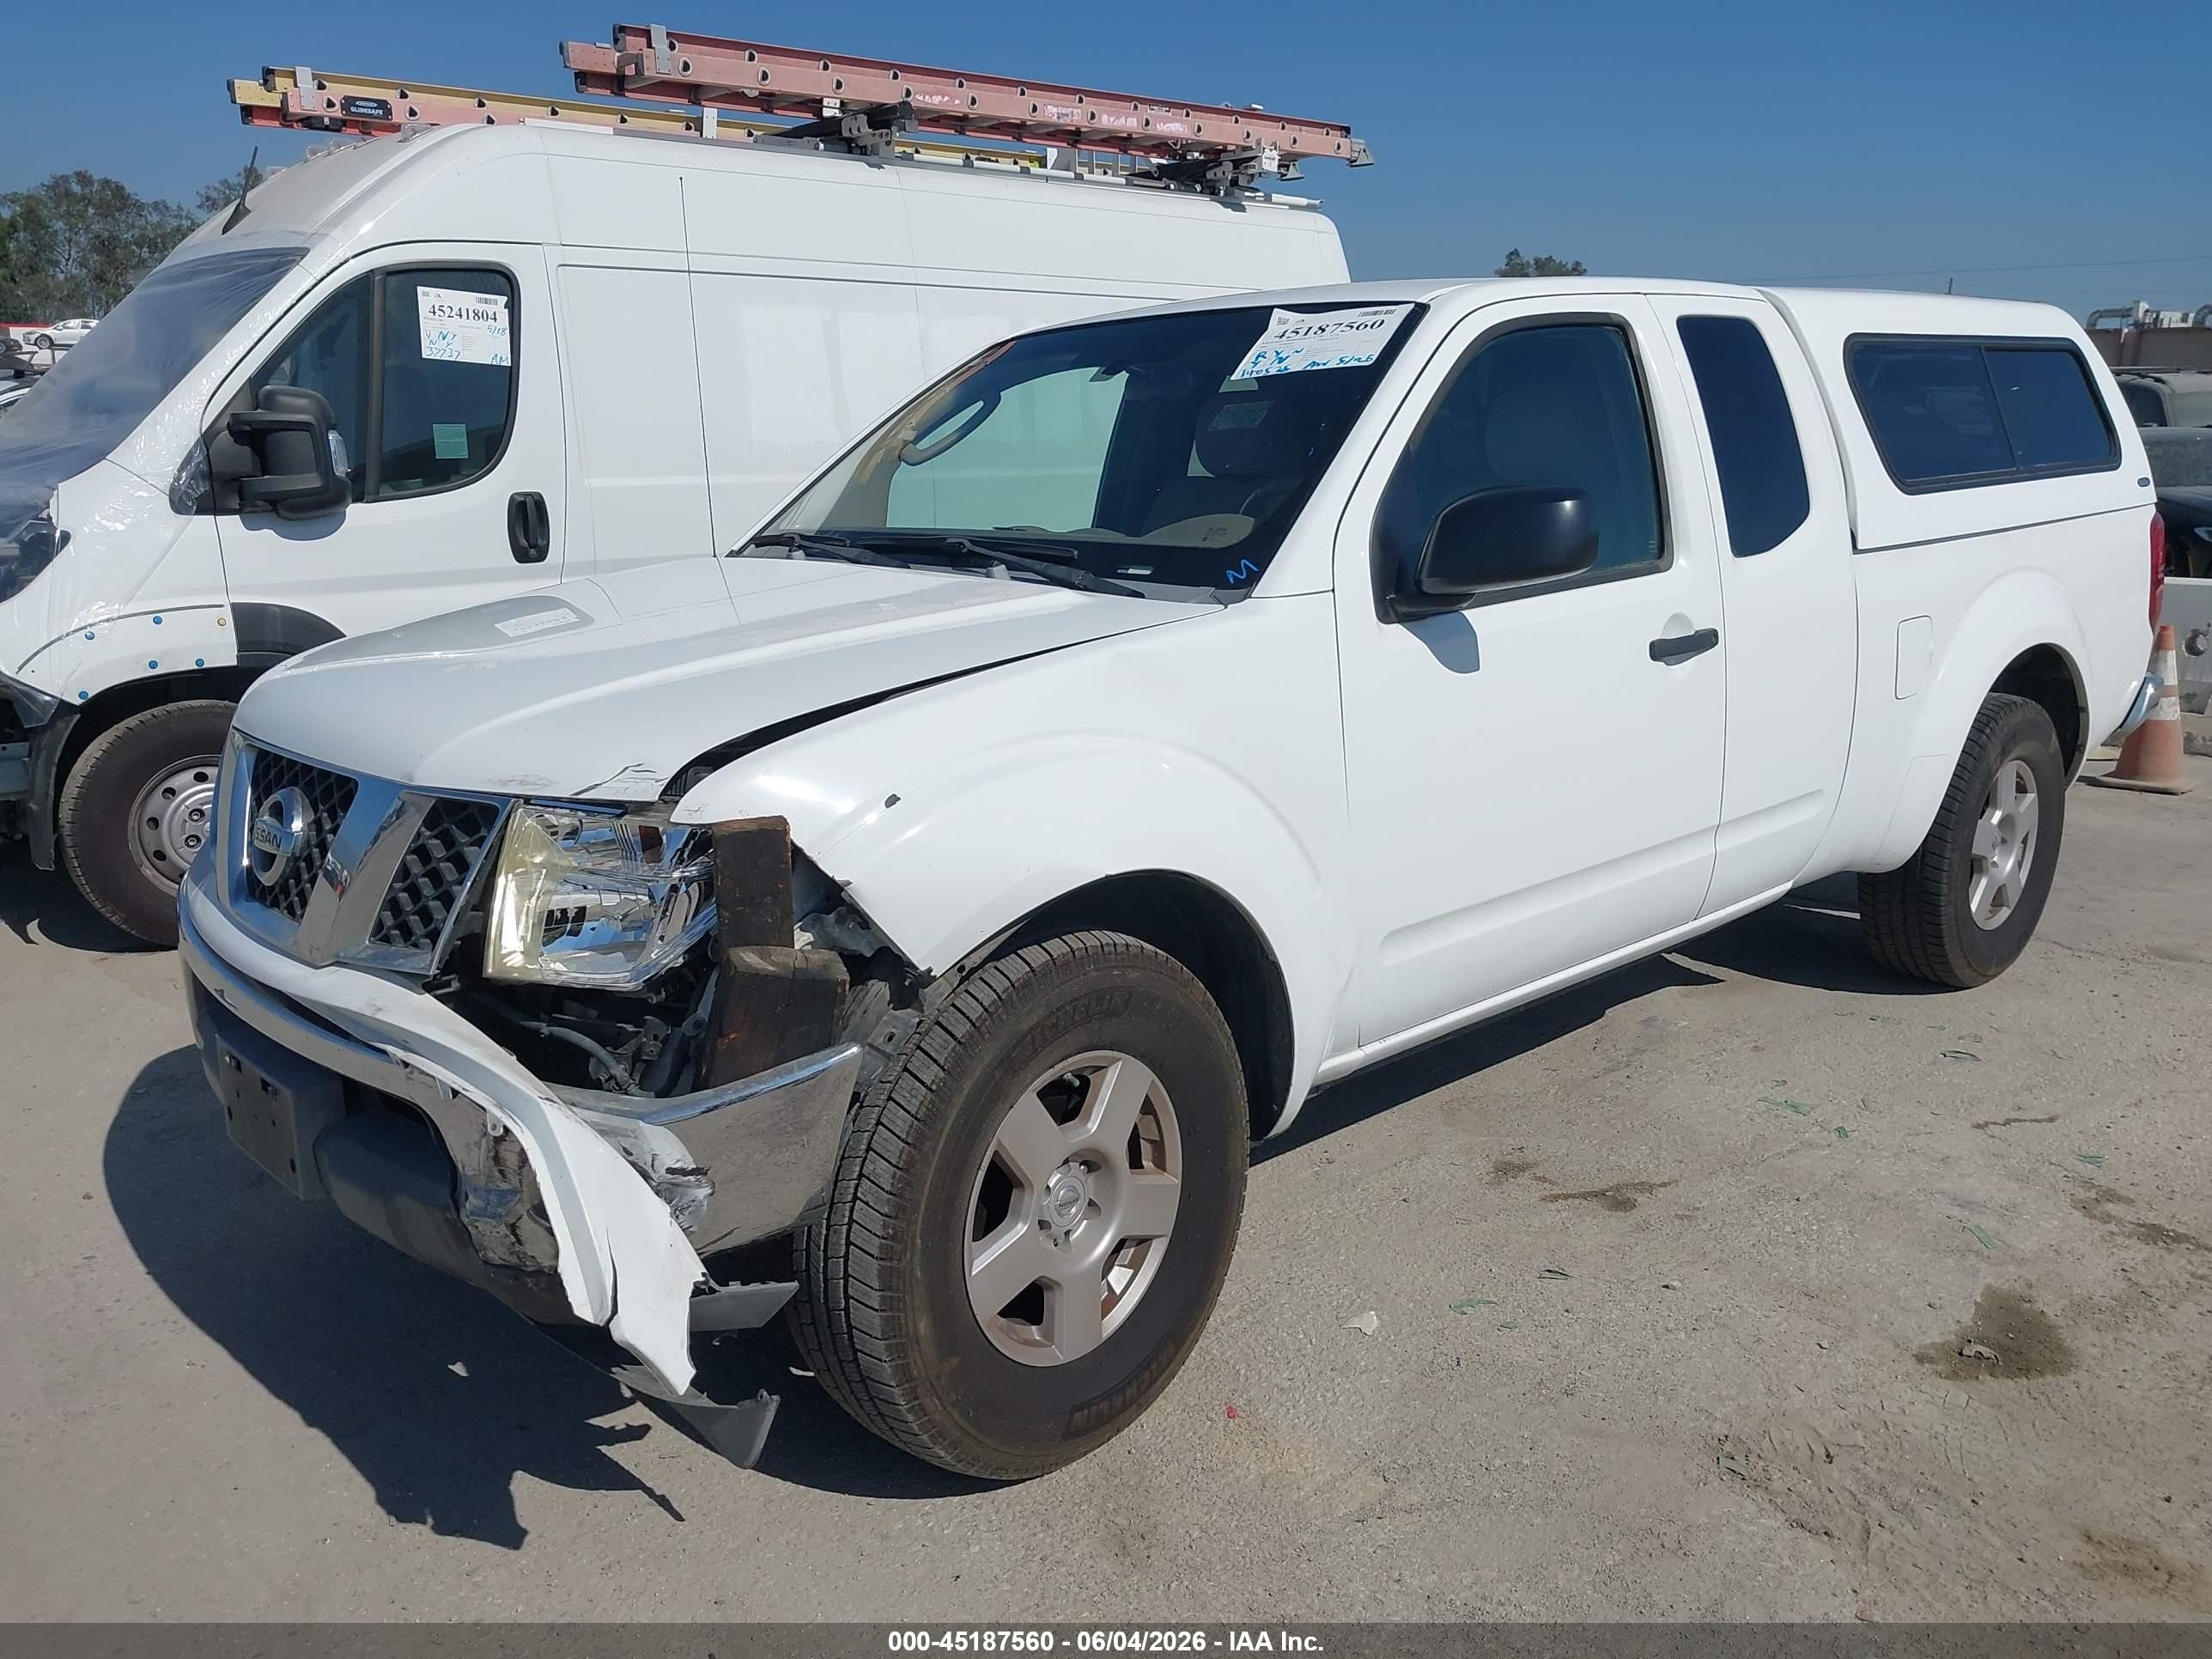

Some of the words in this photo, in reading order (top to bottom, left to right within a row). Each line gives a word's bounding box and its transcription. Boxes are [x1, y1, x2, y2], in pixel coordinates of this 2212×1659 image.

[350, 106, 384, 115] GLIDESAFE
[428, 304, 497, 323] 45241804
[1273, 319, 1385, 339] 45187560
[255, 826, 283, 848] SSAN
